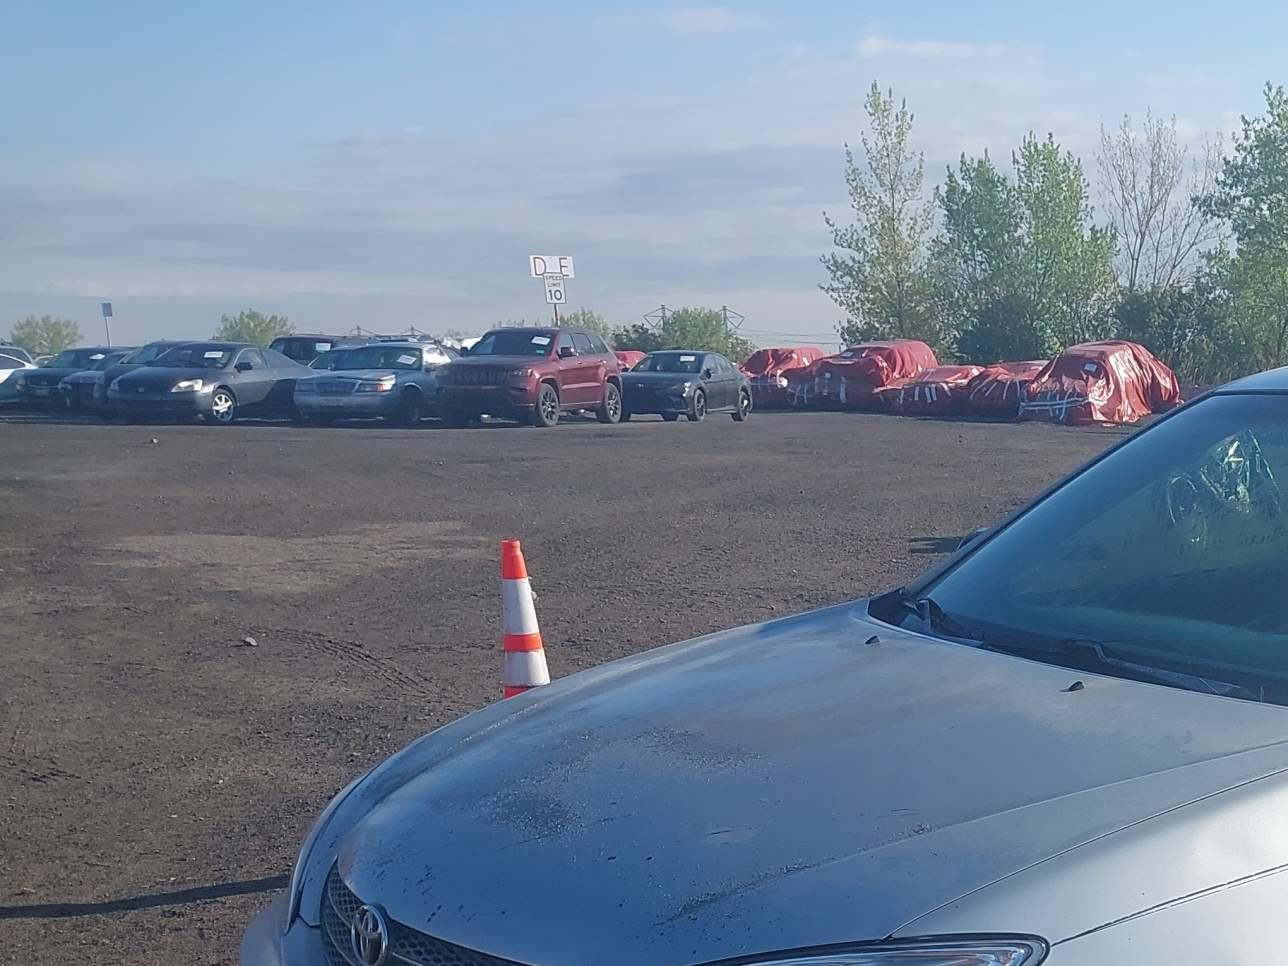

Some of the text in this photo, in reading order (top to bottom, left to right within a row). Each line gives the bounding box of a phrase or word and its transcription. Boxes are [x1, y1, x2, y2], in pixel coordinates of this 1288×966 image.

[533, 256, 569, 277] D E
[548, 289, 562, 301] 10
